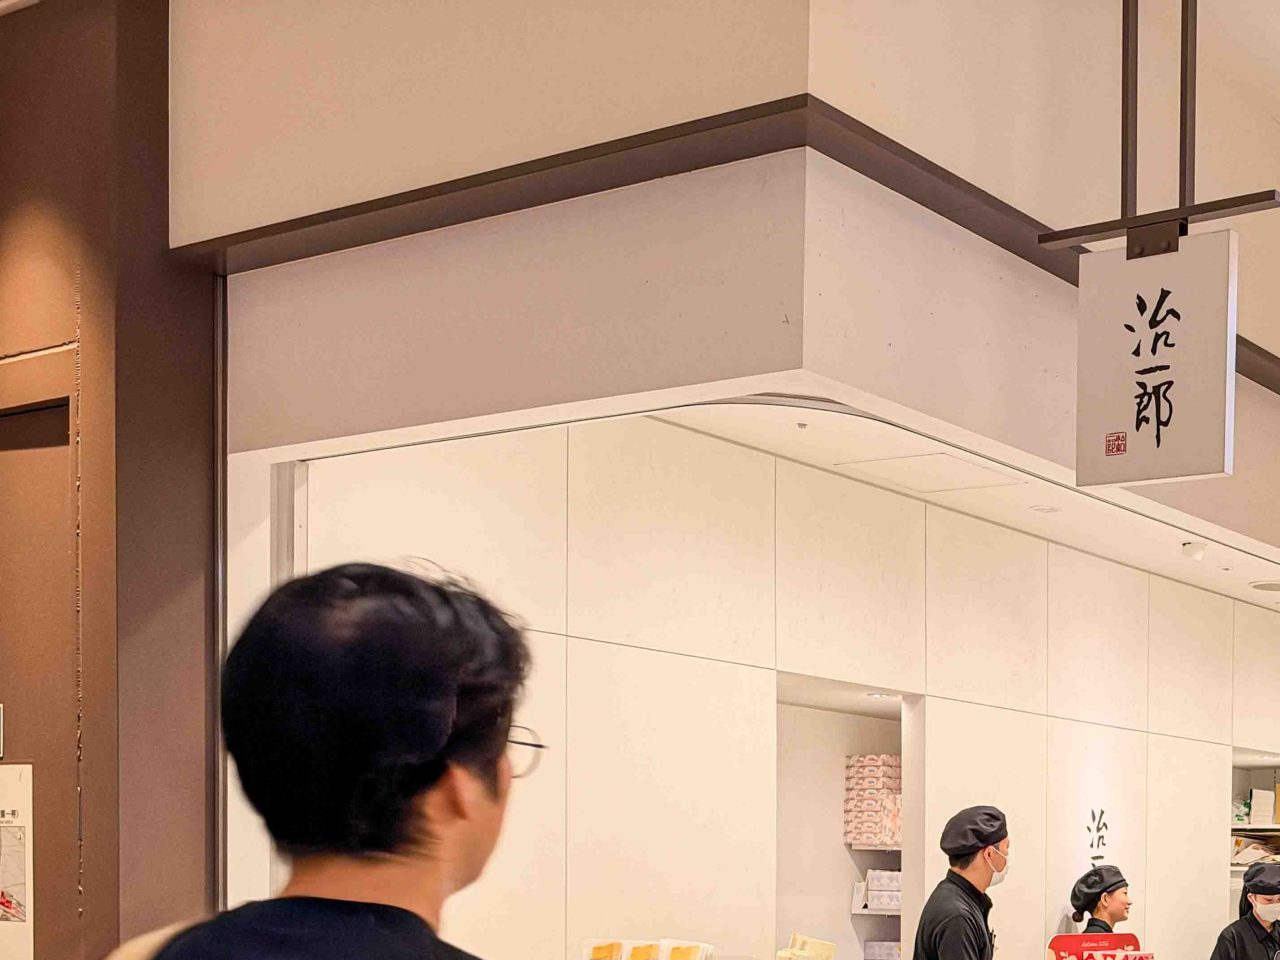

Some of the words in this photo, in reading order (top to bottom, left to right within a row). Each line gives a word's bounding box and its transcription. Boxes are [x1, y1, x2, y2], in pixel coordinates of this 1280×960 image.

[1123, 288, 1181, 448] 治一郎
[1086, 808, 1108, 869] 治一
